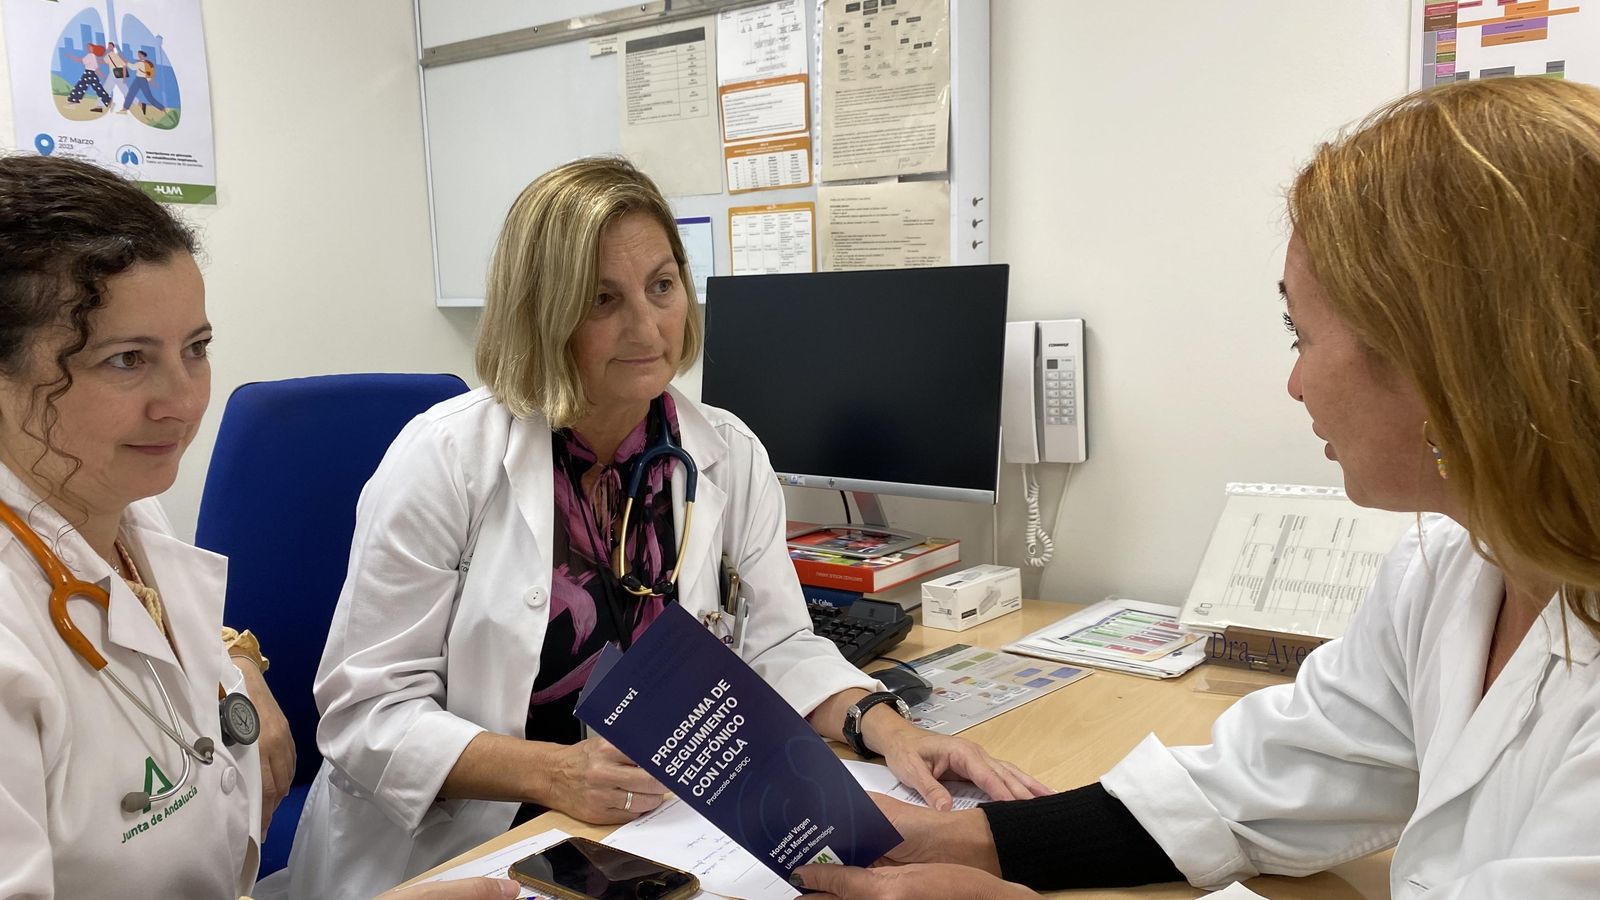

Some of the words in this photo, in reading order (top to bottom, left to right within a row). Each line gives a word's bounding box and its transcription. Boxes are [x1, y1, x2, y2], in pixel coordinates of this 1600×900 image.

[57, 135, 68, 143] 27
[69, 136, 95, 145] Marzo
[1265, 637, 1325, 672] Aye
[603, 687, 639, 726] tucuvi
[651, 697, 715, 767] PROGRAMA
[711, 679, 731, 699] DE
[665, 696, 738, 777] SEGUIMIENTO
[677, 715, 745, 787] TELEFÓNICO
[692, 767, 720, 797] CON
[717, 737, 749, 771] LOLA
[706, 779, 731, 806] Protocolo
[729, 770, 737, 781] de
[735, 756, 751, 776] EPOC
[121, 820, 150, 844] Junta
[150, 811, 163, 826] de
[164, 785, 198, 818] Andalucía
[769, 832, 795, 858] Hospital
[791, 817, 811, 837] Virgen
[777, 854, 787, 864] de
[785, 847, 793, 857] la
[790, 824, 818, 850] Macarena
[785, 849, 804, 870] Unidad
[802, 844, 811, 853] de
